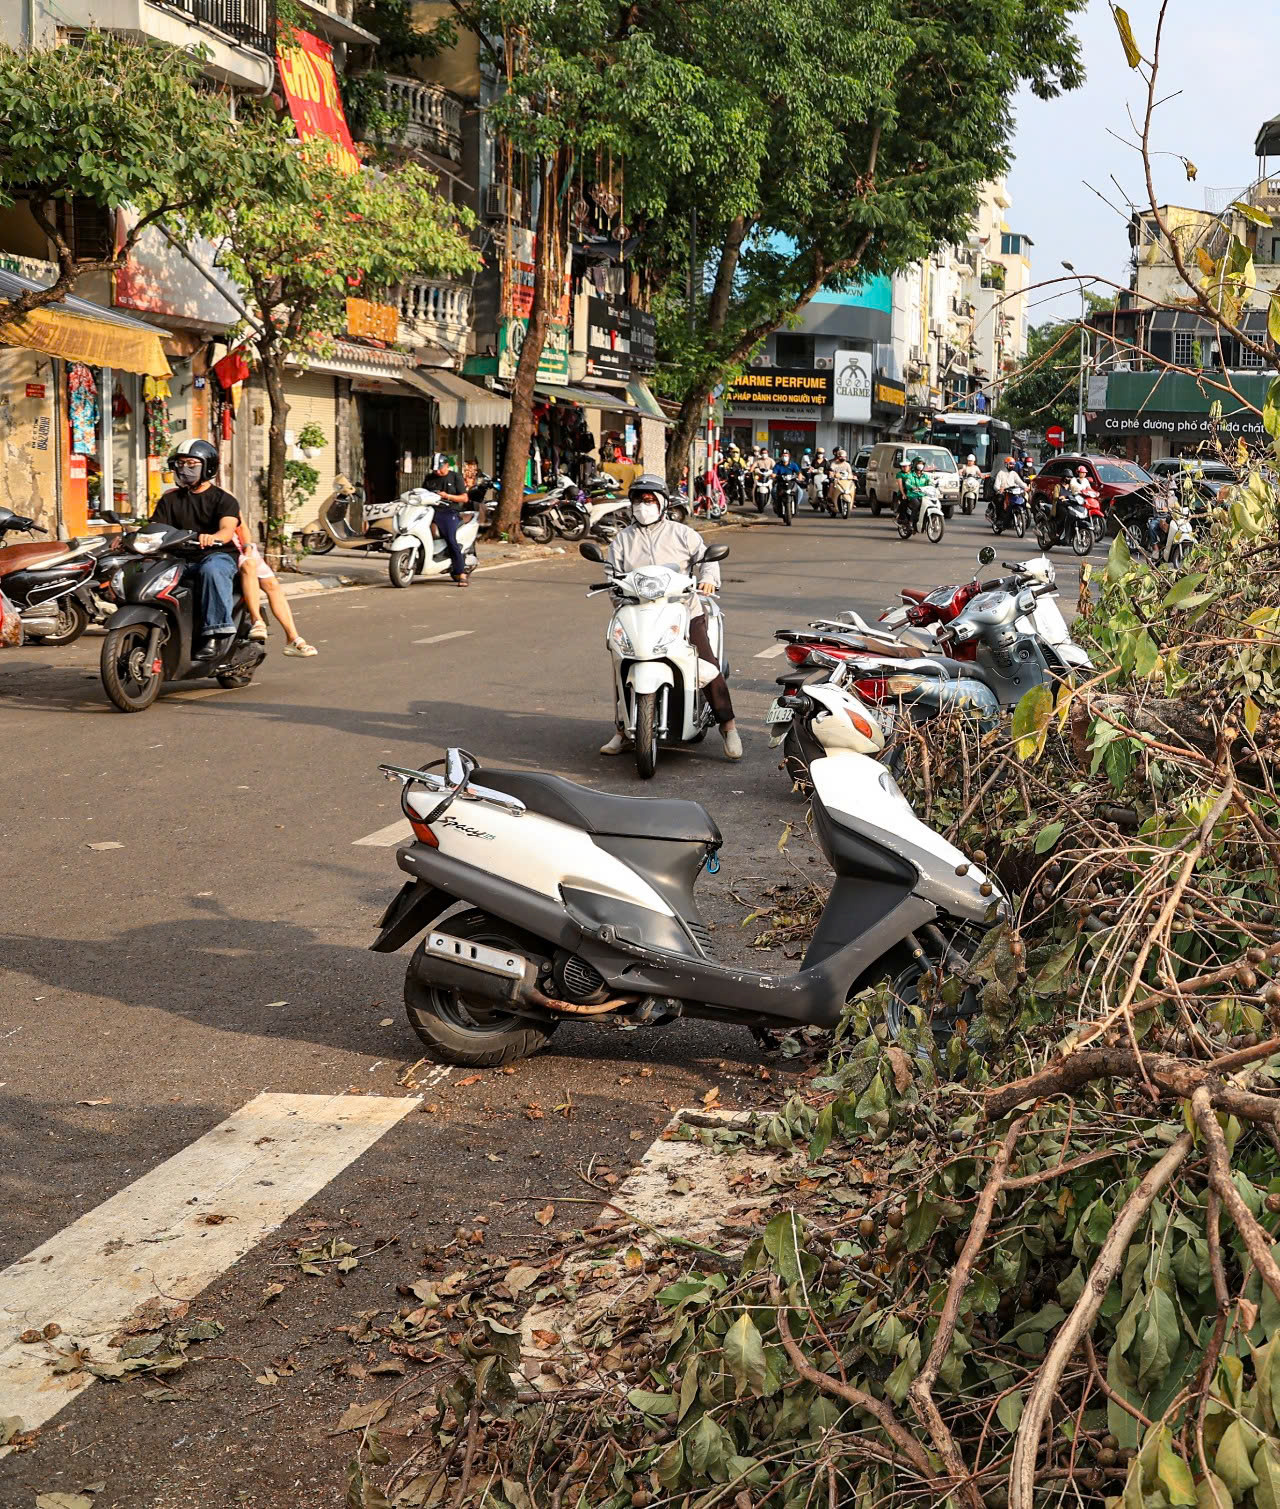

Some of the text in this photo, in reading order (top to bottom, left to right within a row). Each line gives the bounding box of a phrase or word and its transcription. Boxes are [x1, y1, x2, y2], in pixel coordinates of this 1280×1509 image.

[775, 375, 827, 389] PERFUME
[752, 392, 771, 402] DÀNH
[773, 394, 787, 403] CHO
[812, 394, 827, 405] VIỆT
[836, 386, 870, 398] CHARME
[1105, 418, 1119, 429] Cà
[1143, 419, 1175, 432] đường
[1177, 419, 1198, 433] phố
[1242, 420, 1266, 433] chất
[436, 816, 487, 839] Spacy
